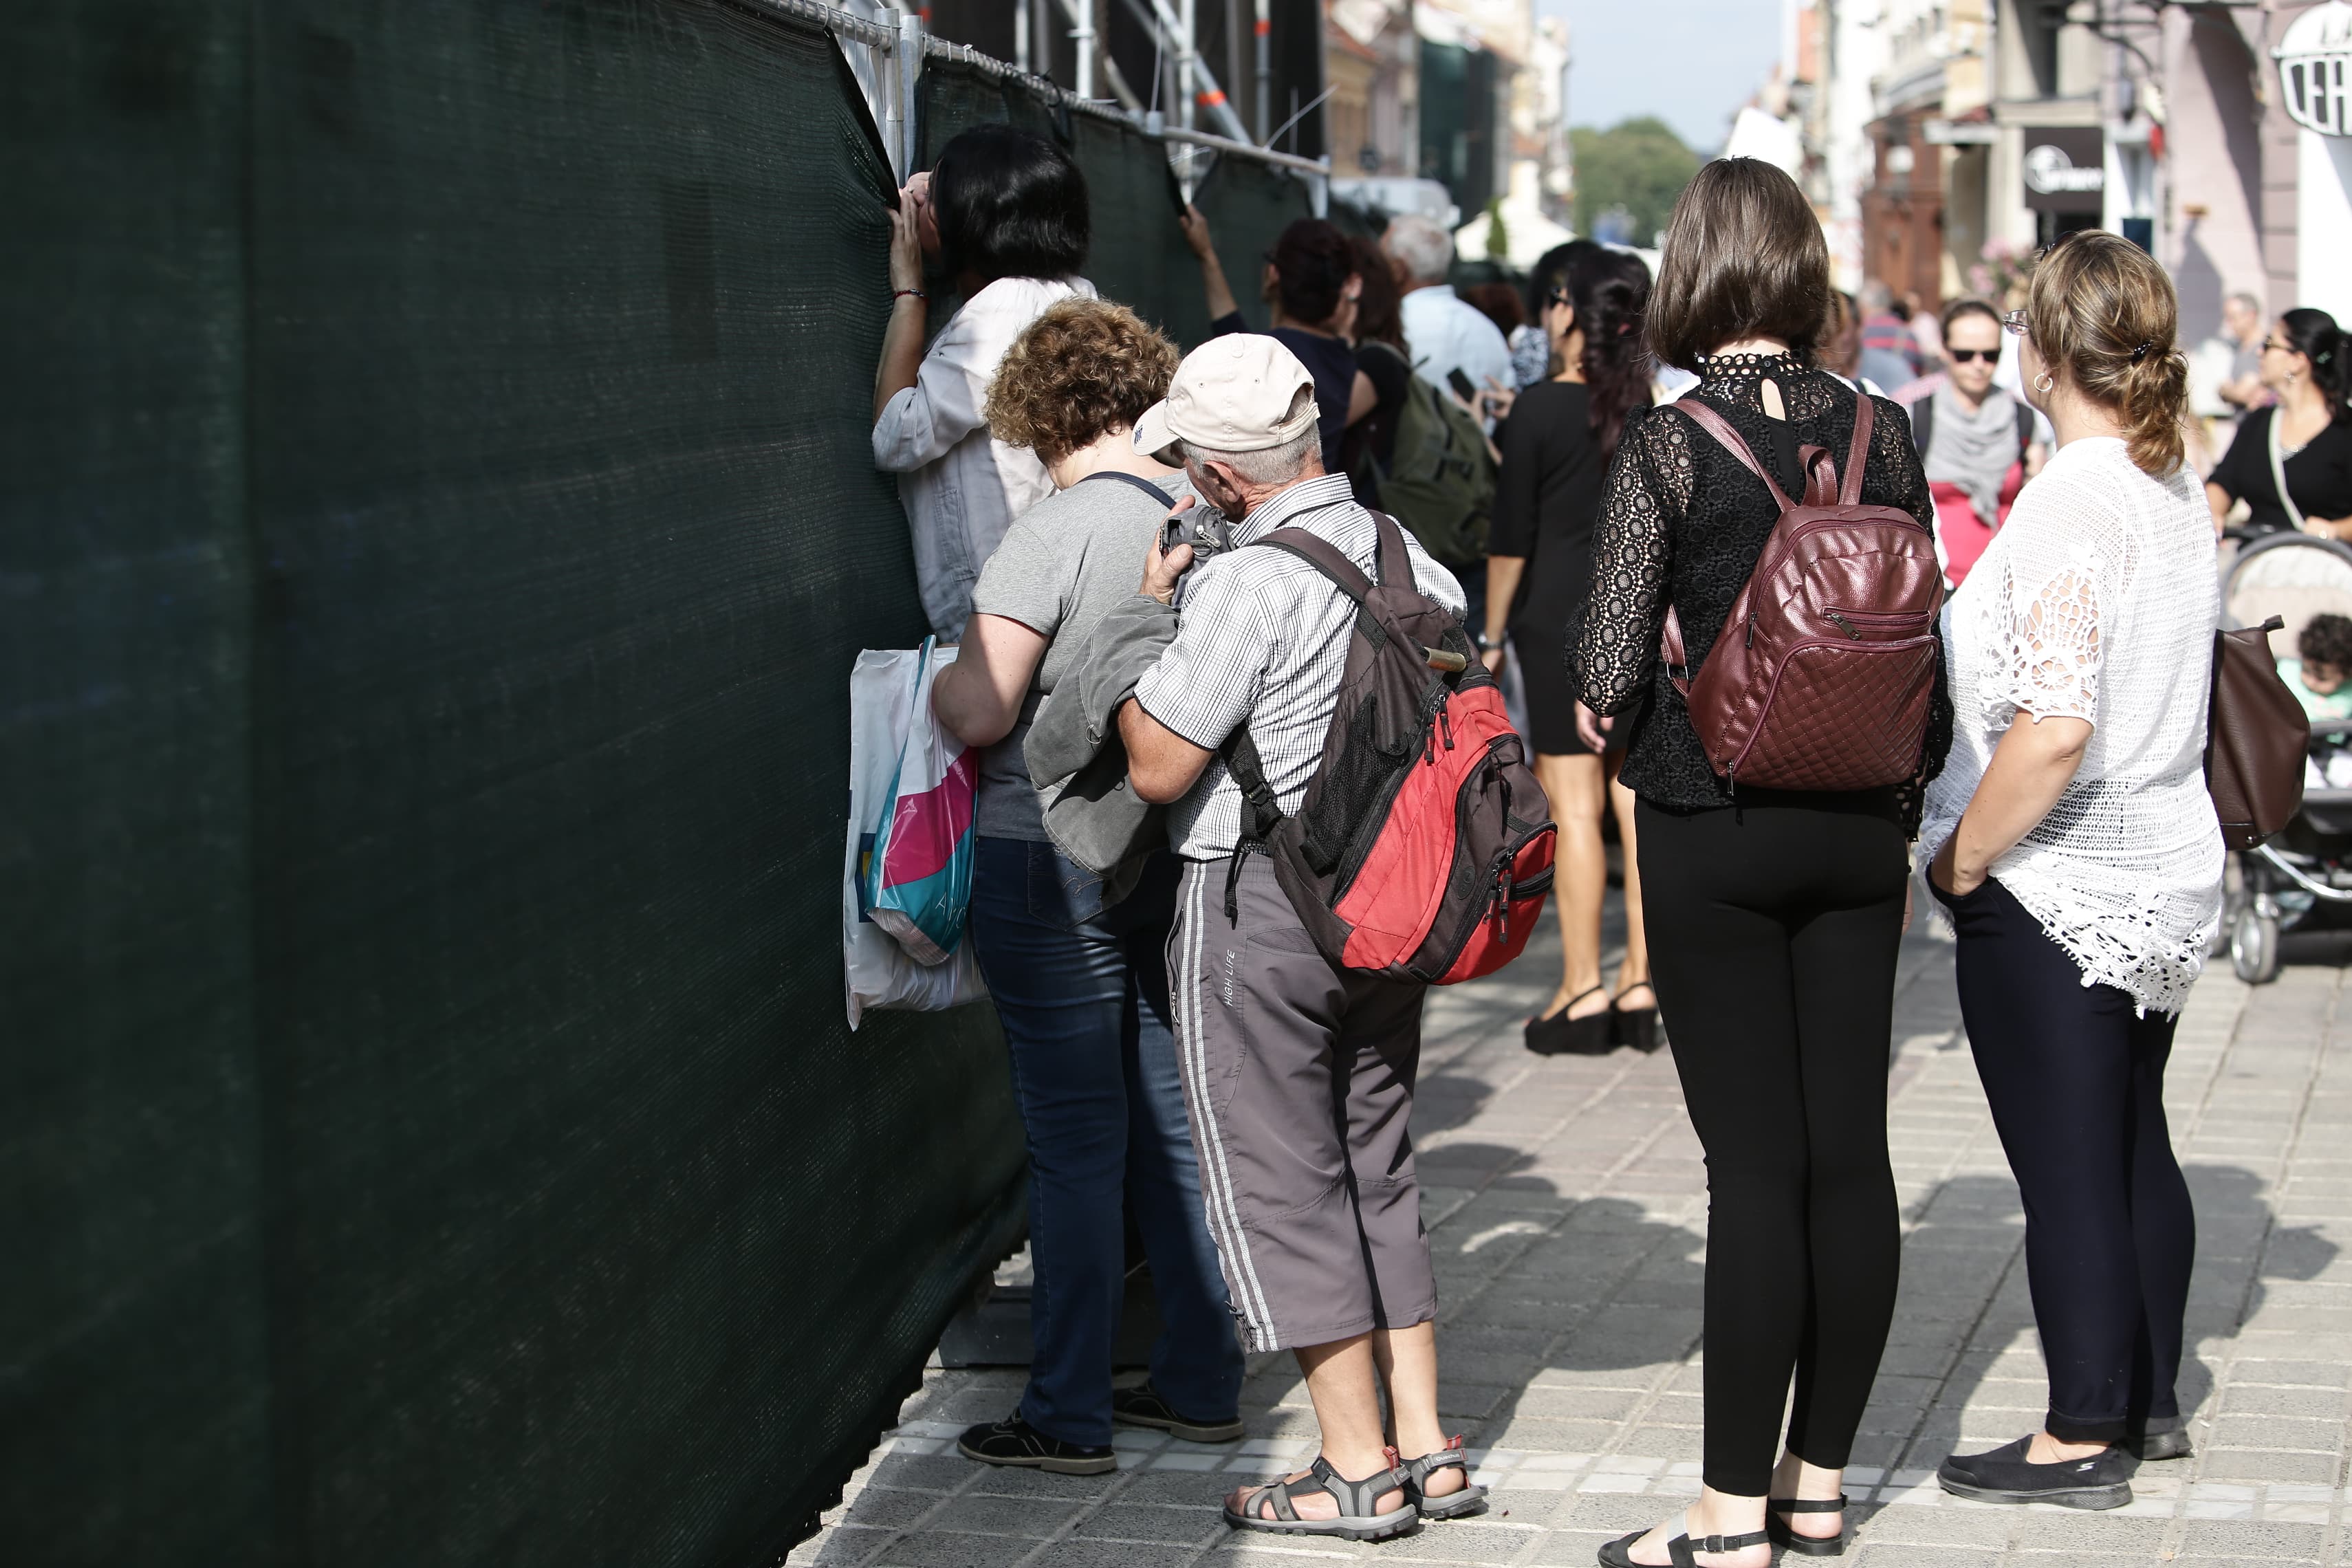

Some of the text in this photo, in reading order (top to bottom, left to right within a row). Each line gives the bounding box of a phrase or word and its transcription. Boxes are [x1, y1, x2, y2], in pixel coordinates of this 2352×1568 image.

[1223, 949, 1235, 1007] HIGH LIFE
[1435, 1452, 1460, 1462] Quechua
